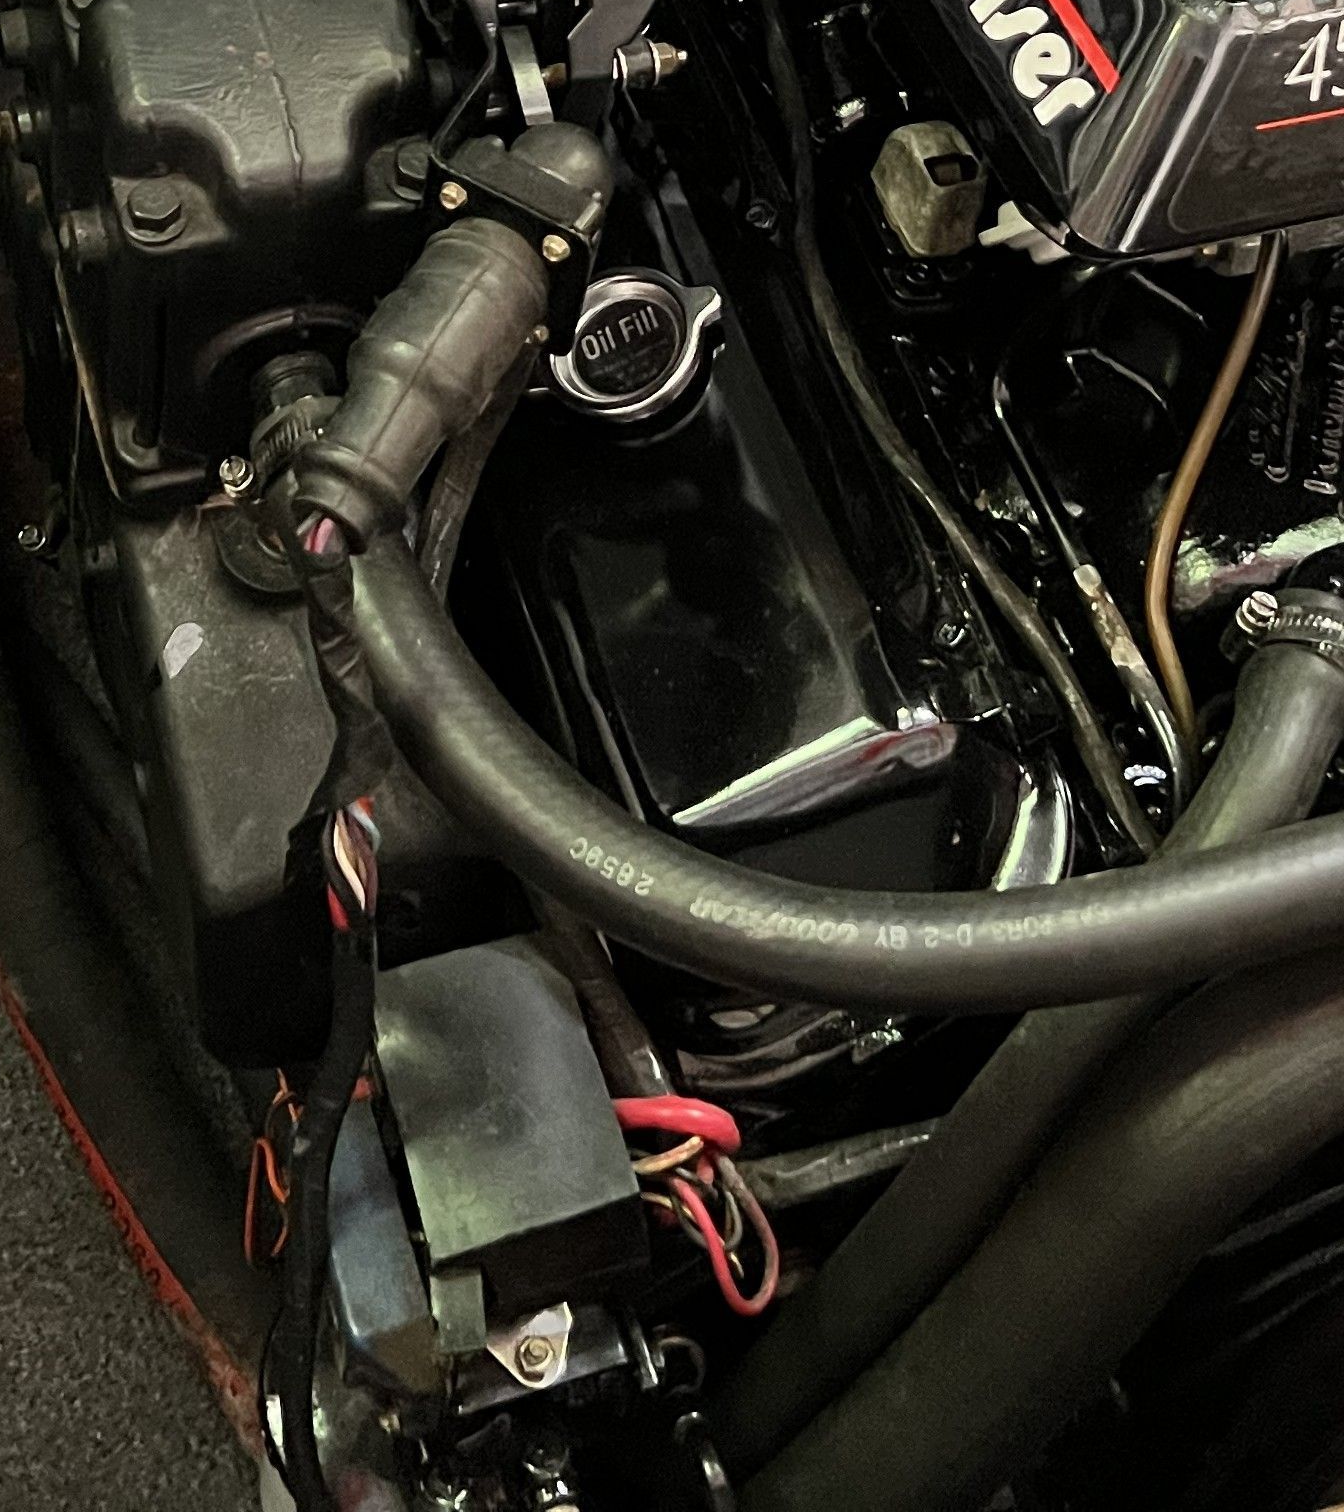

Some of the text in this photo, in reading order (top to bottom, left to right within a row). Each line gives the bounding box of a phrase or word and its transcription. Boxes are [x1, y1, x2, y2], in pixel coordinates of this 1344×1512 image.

[580, 305, 661, 360] Oil Fill
[874, 923, 909, 951] BY
